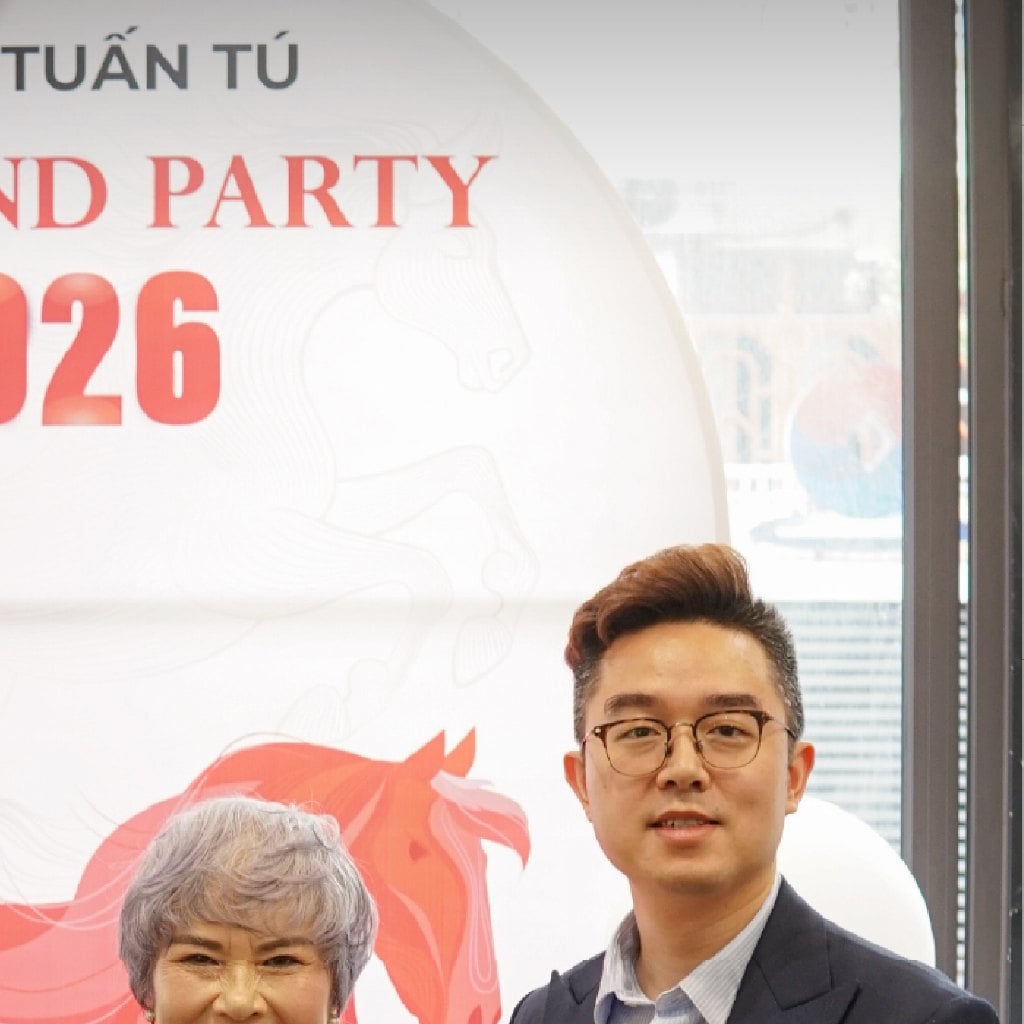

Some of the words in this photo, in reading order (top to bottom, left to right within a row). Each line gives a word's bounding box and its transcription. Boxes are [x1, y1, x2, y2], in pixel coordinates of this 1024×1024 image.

[0, 26, 189, 91] TUẤN
[212, 30, 299, 89] TÚ
[146, 154, 499, 229] PARTY
